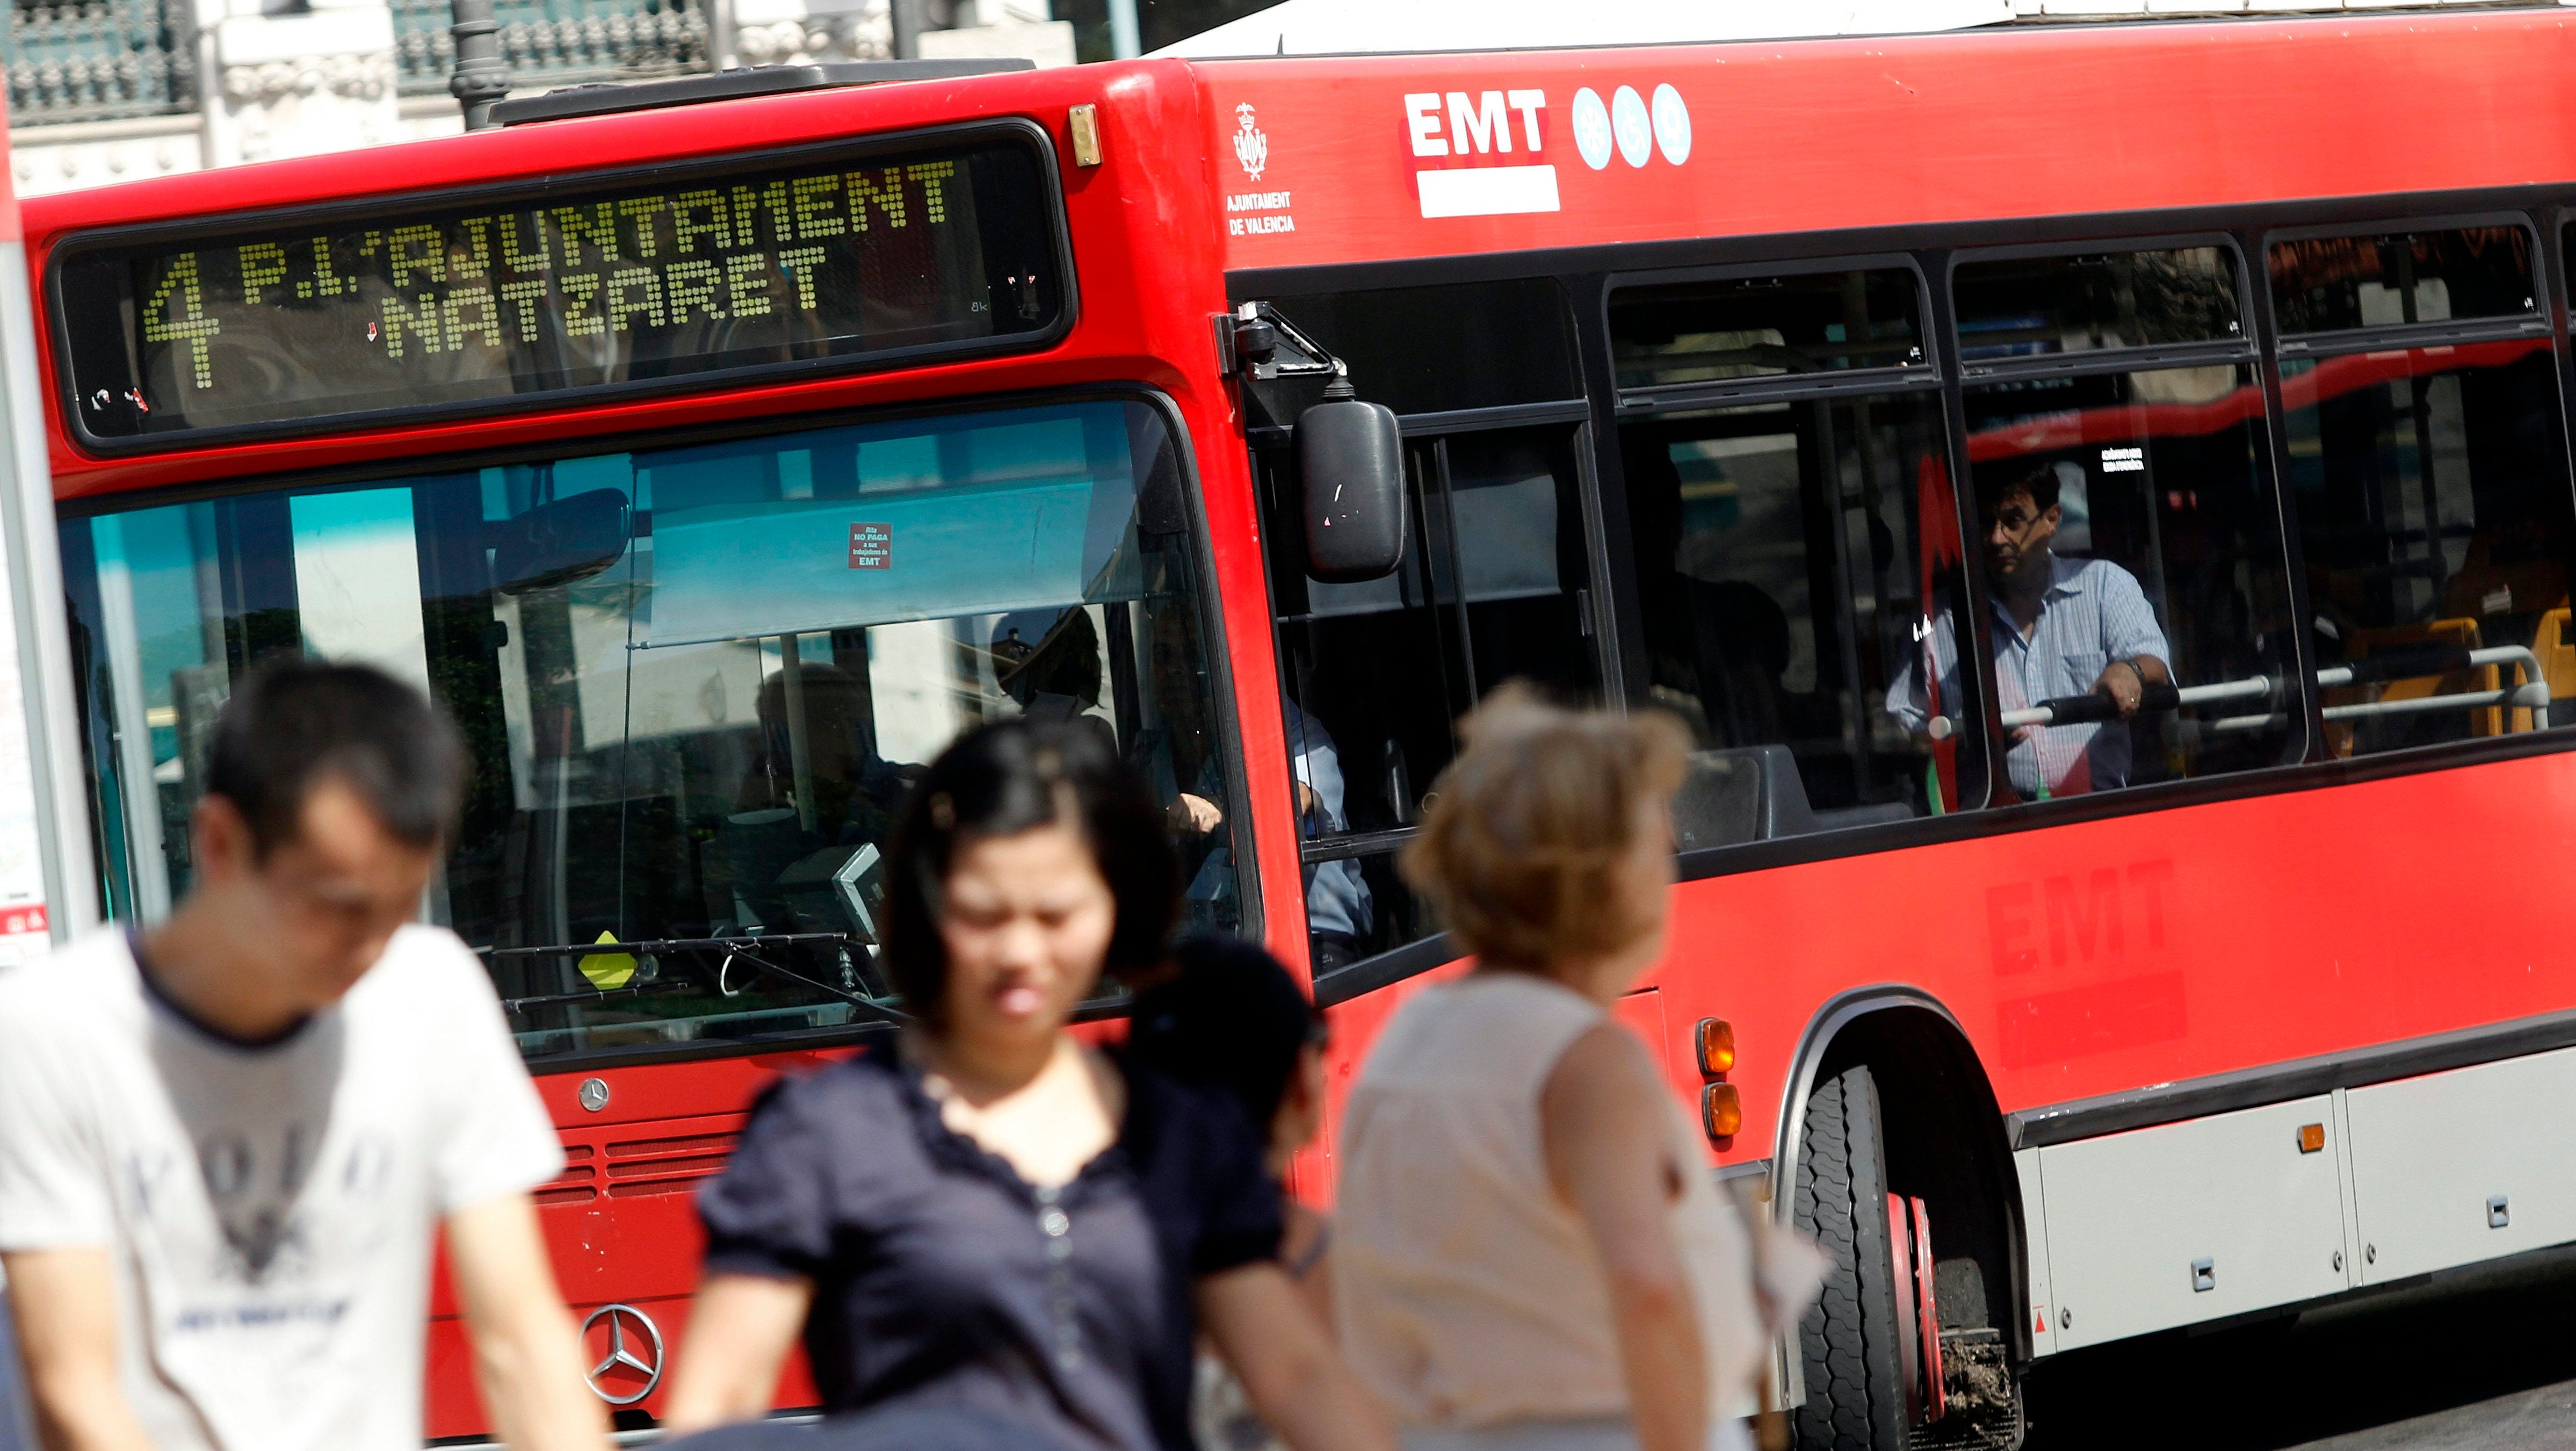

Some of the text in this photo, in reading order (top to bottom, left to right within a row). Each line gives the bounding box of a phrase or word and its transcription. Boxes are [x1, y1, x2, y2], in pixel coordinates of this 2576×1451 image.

[1404, 89, 1546, 157] EMT
[1227, 191, 1291, 212] AJUNTAMENT
[1229, 215, 1296, 236] DE VALENCIA
[143, 252, 220, 389] 4
[382, 247, 826, 358] NATZARET
[859, 557, 881, 566] EMT
[1985, 858, 2174, 977] EMT
